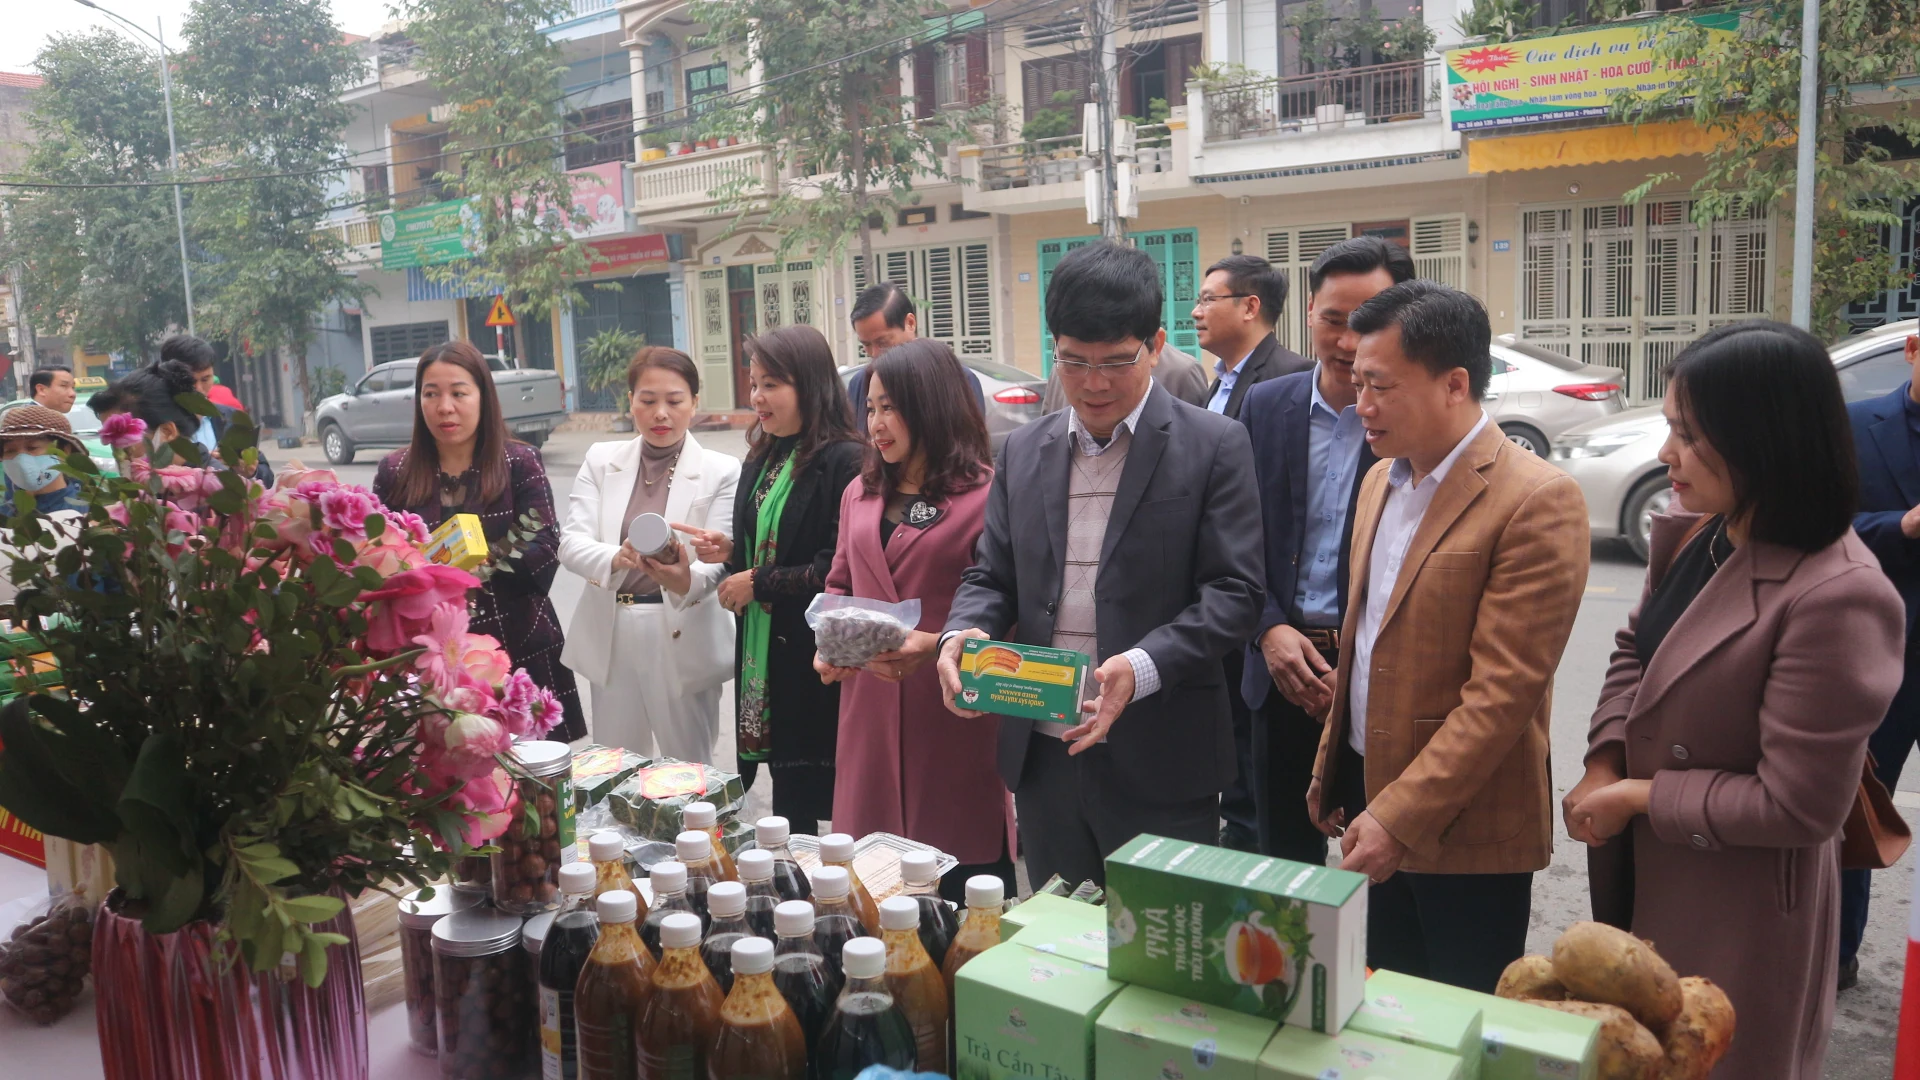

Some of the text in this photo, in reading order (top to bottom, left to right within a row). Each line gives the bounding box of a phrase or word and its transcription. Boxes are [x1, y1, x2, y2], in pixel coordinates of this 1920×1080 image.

[1563, 42, 1602, 61] dịch
[1608, 42, 1631, 55] vụ
[1473, 80, 1491, 96] HỘI
[1494, 78, 1520, 93] NGHỊ
[1530, 74, 1557, 88] SINH
[1560, 68, 1590, 85] NHẬT
[1600, 65, 1624, 80] HOA
[998, 689, 1022, 697] BANANA
[1141, 907, 1169, 960] TRÀ
[963, 1035, 992, 1062] Trà
